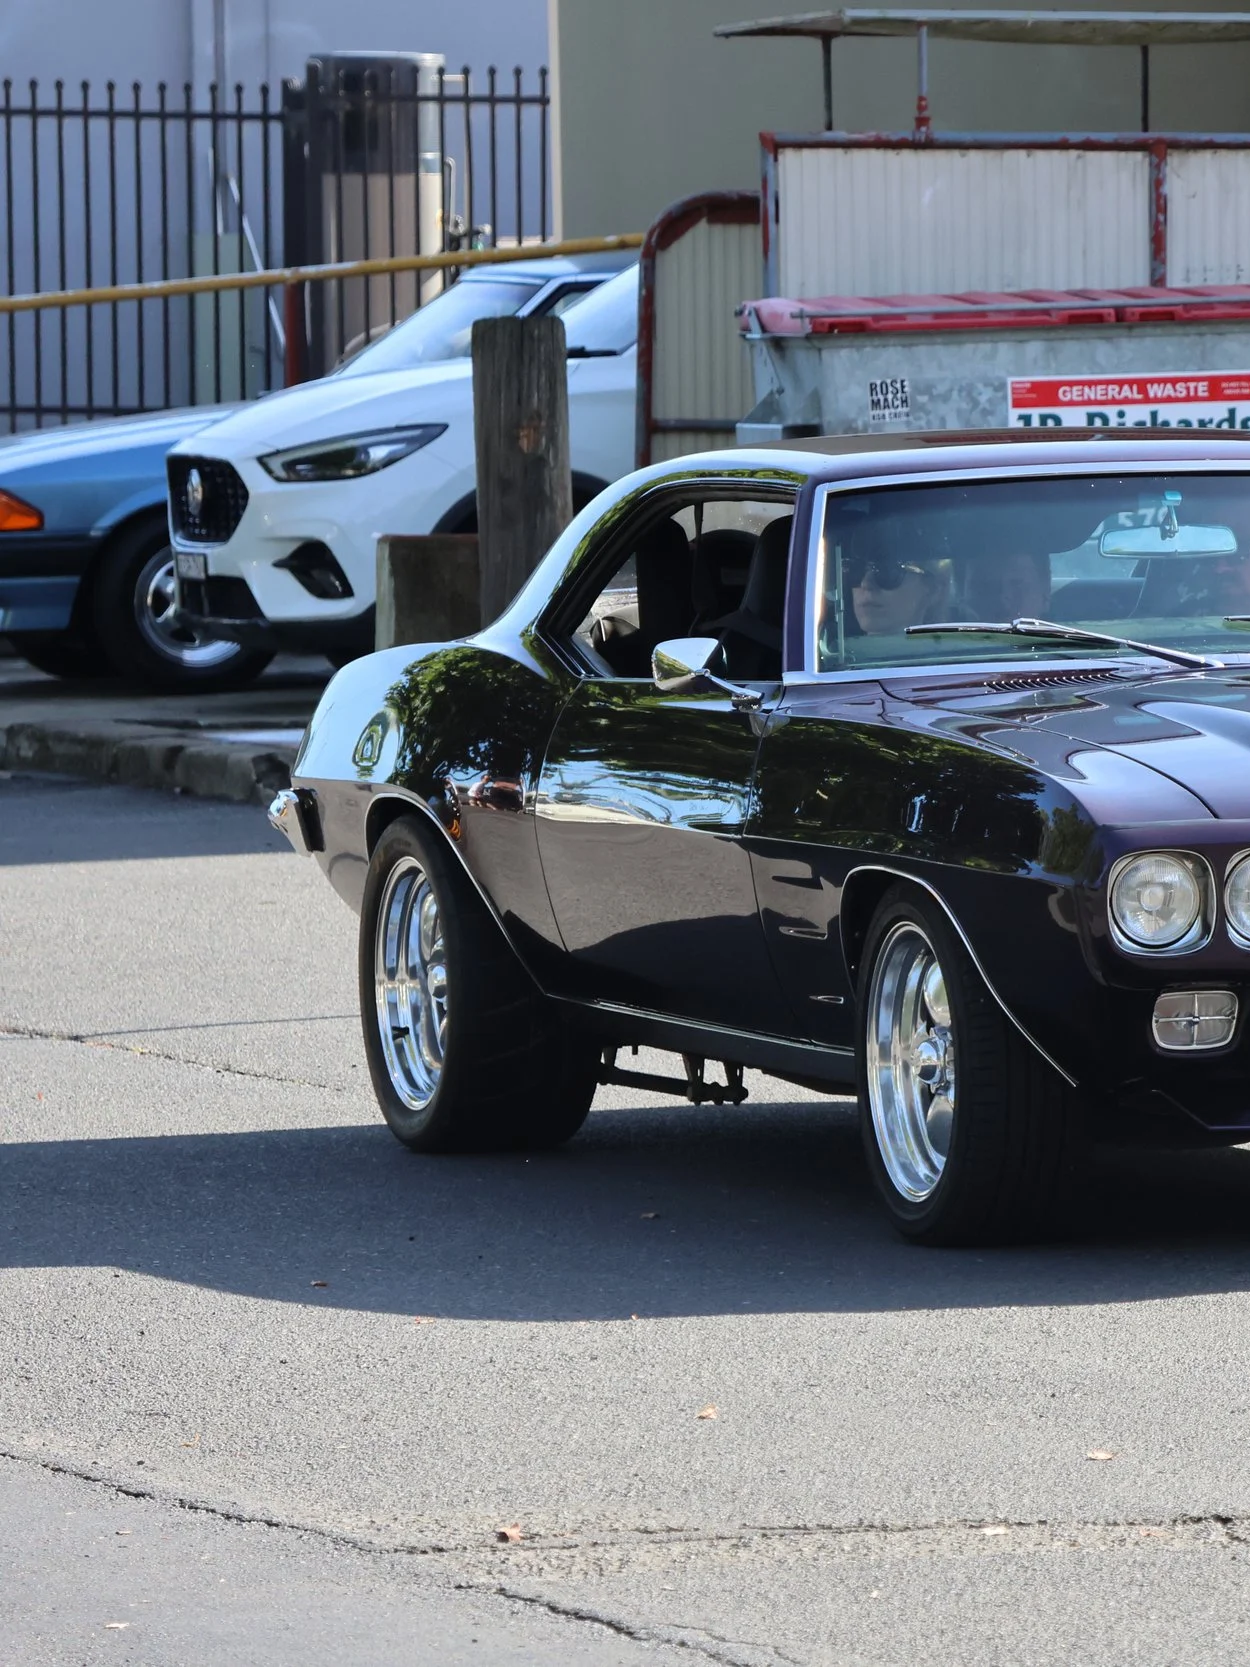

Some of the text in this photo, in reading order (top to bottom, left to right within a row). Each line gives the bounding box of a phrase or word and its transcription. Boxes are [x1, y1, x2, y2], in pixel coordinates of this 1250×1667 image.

[870, 379, 908, 397] ROSE
[1058, 383, 1144, 401] GENERAL
[1146, 381, 1210, 398] WASTE
[871, 394, 909, 411] MACH
